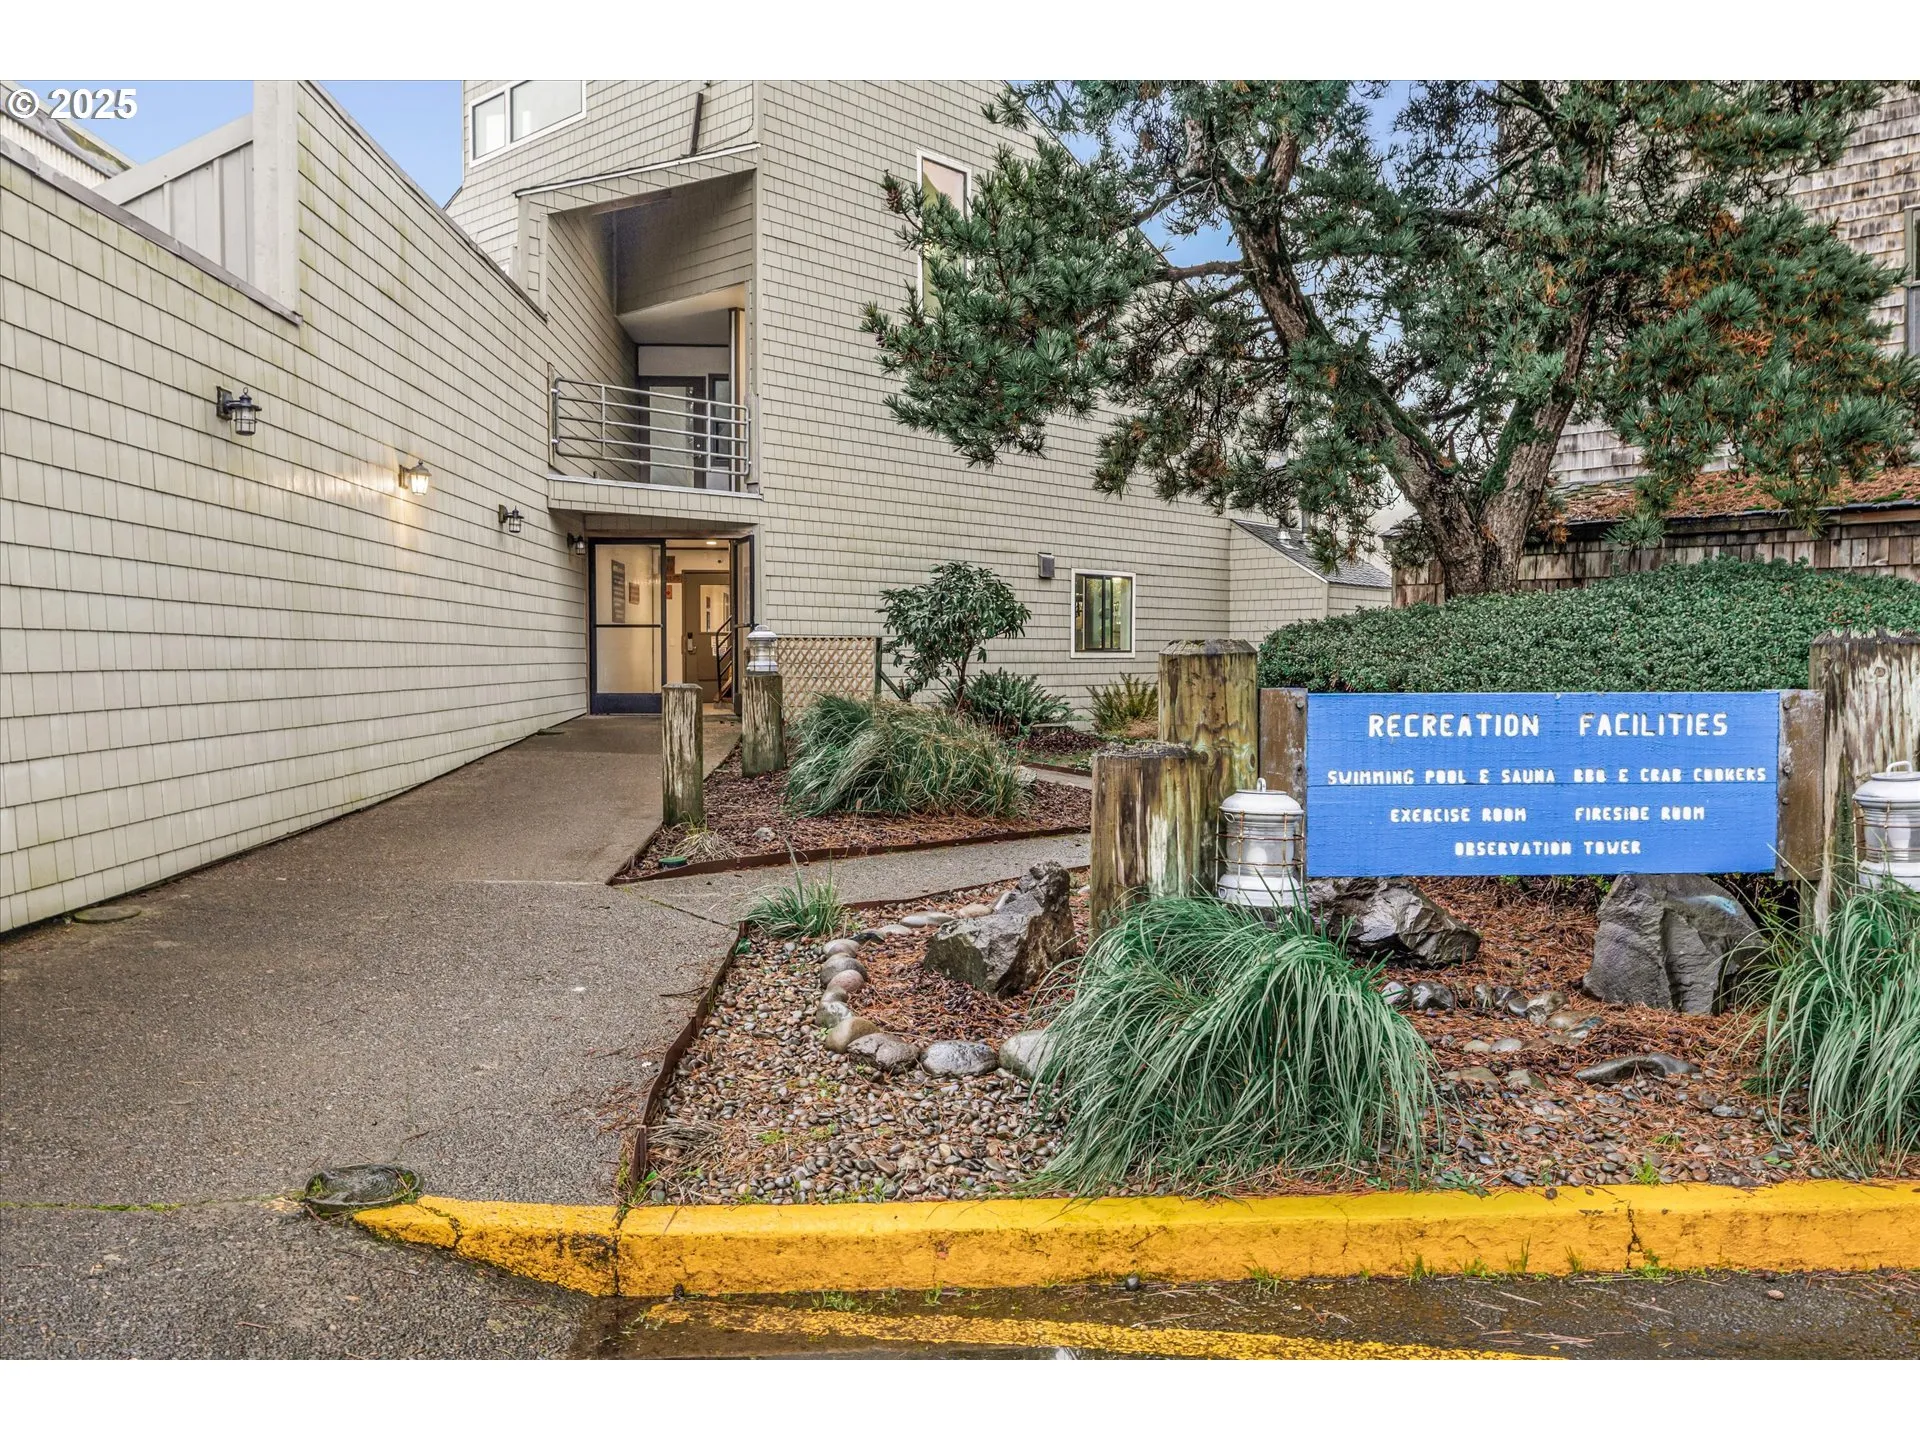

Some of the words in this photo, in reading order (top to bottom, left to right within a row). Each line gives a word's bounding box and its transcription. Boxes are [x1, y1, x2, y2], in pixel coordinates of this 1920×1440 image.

[1367, 713, 1540, 738] RECREATION
[1579, 711, 1729, 737] FACILITIES
[1327, 769, 1415, 785] SWIMMING
[1425, 769, 1467, 785] POOL
[1501, 768, 1556, 784] SAUNA
[1573, 768, 1607, 784] BBQ
[1640, 767, 1683, 783] CRAB
[1693, 767, 1767, 783] COOKERS
[1390, 807, 1471, 823] EXERCISE
[1481, 807, 1527, 822] ROOM
[1574, 806, 1650, 821] FIRESIDE
[1660, 806, 1705, 821] ROOM
[1454, 841, 1572, 857] OBSERVATION
[1583, 840, 1642, 855] TOWER
